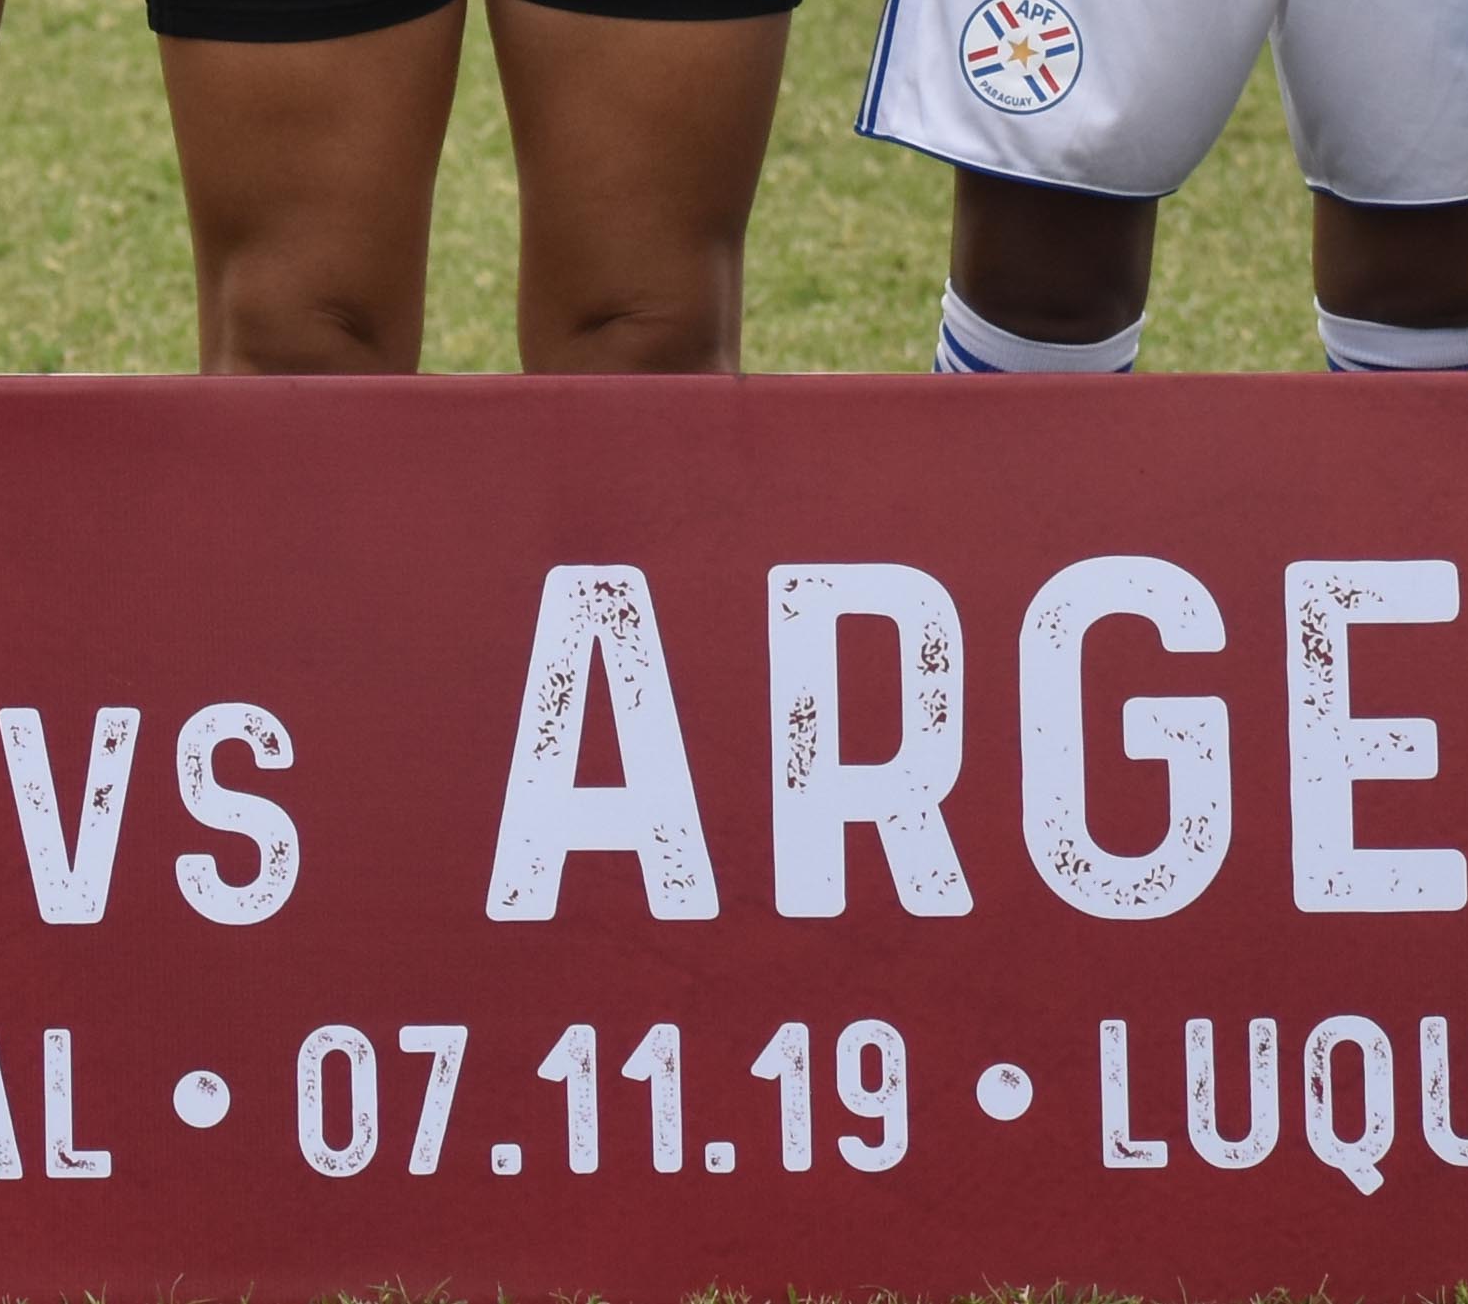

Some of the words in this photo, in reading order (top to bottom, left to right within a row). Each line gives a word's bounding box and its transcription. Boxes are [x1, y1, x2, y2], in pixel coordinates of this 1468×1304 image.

[1015, 0, 1056, 26] APF
[979, 80, 1033, 107] PARAGUAY
[297, 1019, 909, 1178] 07.11.19
